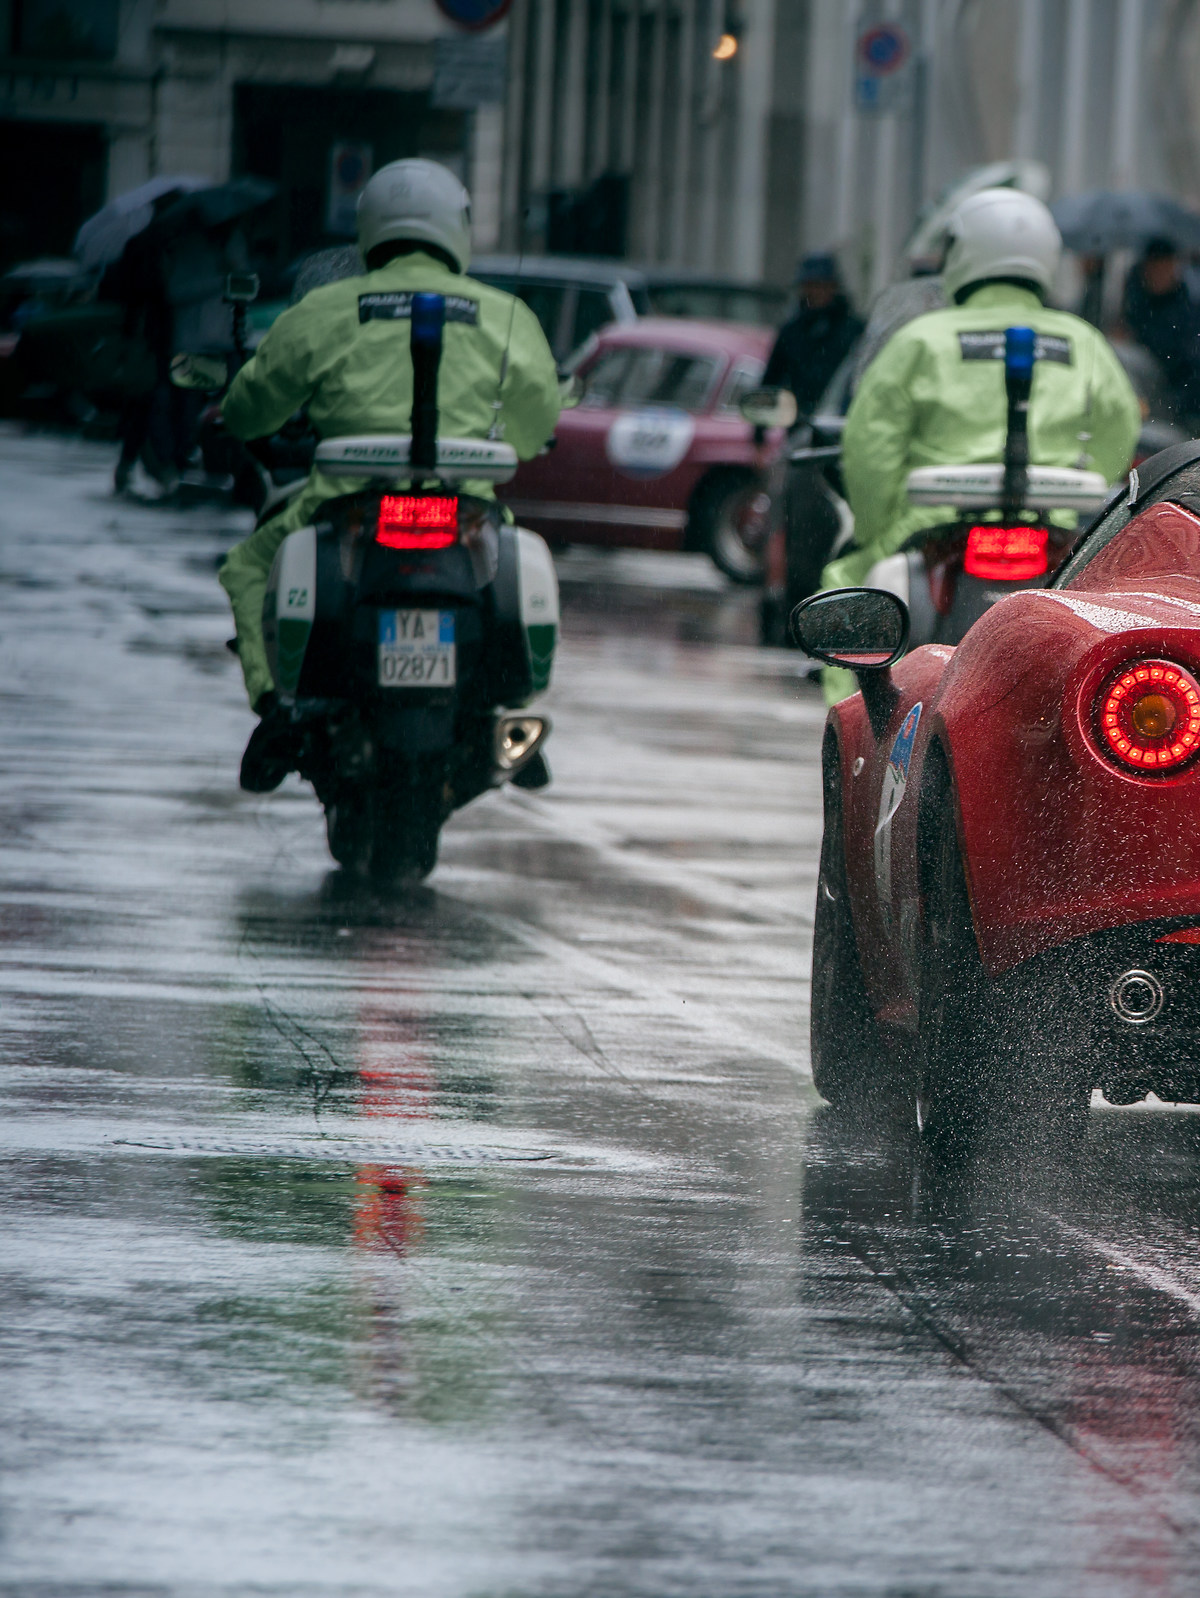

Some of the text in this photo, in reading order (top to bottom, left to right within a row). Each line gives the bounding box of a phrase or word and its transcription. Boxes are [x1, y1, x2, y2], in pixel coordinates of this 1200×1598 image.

[343, 446, 495, 459] POLIZIA LOCALE
[399, 610, 425, 638] YA
[382, 655, 450, 681] 02871
